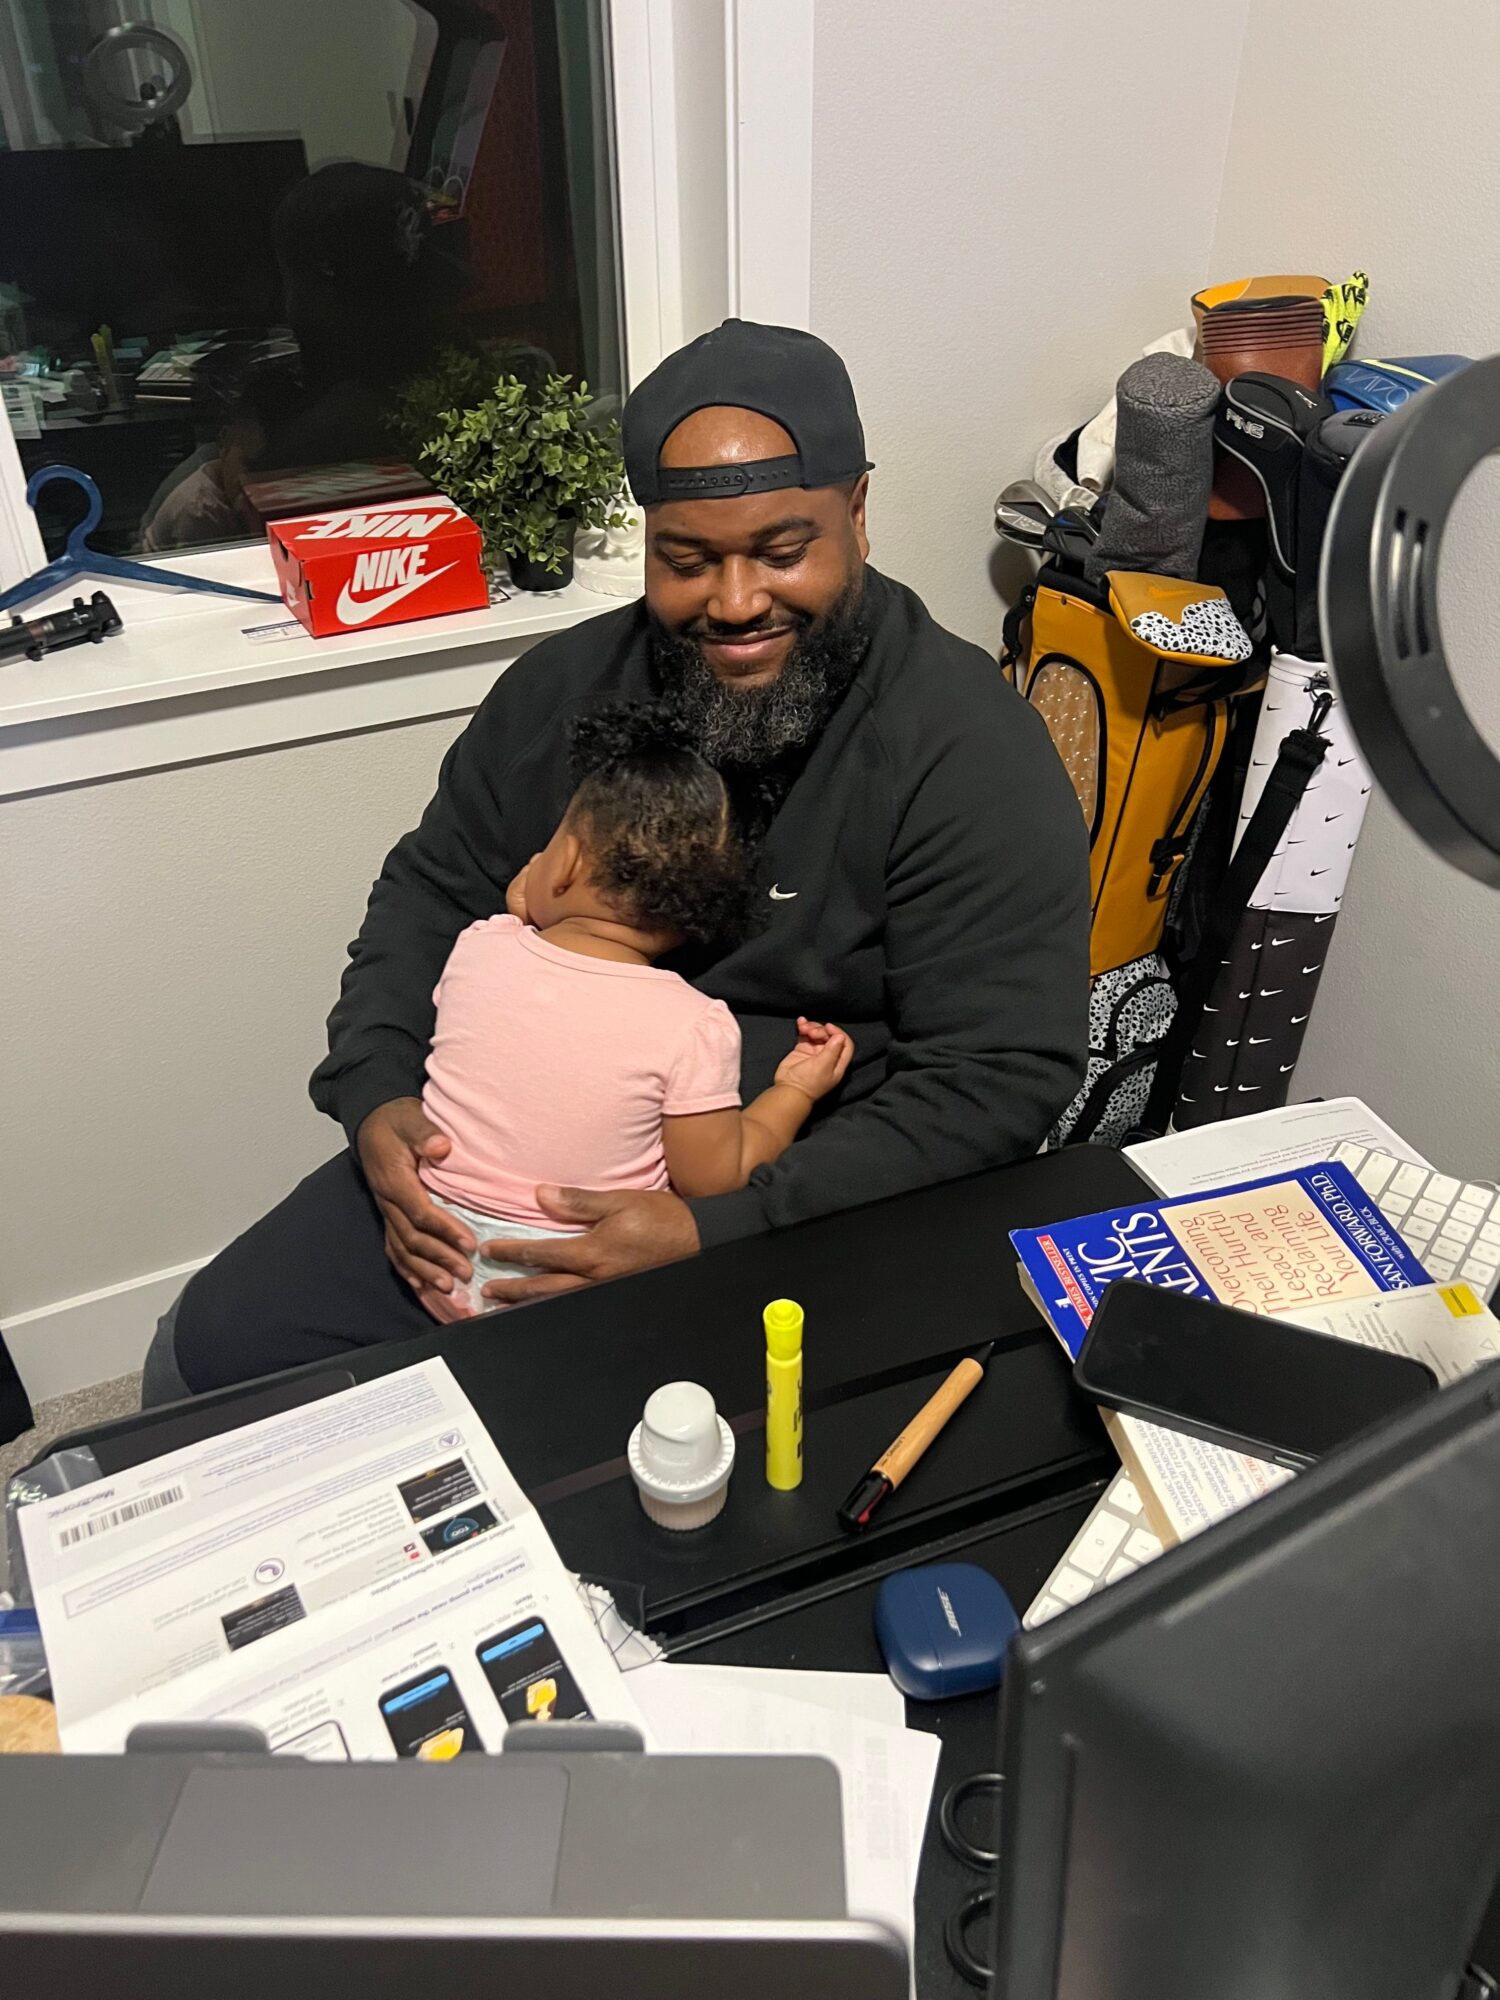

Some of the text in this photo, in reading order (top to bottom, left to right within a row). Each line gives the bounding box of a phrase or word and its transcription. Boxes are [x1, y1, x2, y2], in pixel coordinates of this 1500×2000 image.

[1346, 369, 1409, 408] VAPO
[1226, 407, 1264, 439] PING
[295, 514, 451, 540] NIKE
[351, 544, 429, 593] NIKE
[1310, 1171, 1340, 1200] Ph.D.
[1264, 1205, 1343, 1297] Reclaiming
[1297, 1211, 1360, 1281] Your Life
[1358, 1205, 1405, 1260] with CRAIG BUCK
[1041, 1239, 1088, 1312] TIMES BESTSELLER
[1062, 1247, 1094, 1294] COPIES IN PRINT
[1208, 1210, 1279, 1314] Their Hurtful
[1232, 1213, 1313, 1303] Legacy and
[46, 1488, 114, 1519] Medtronic
